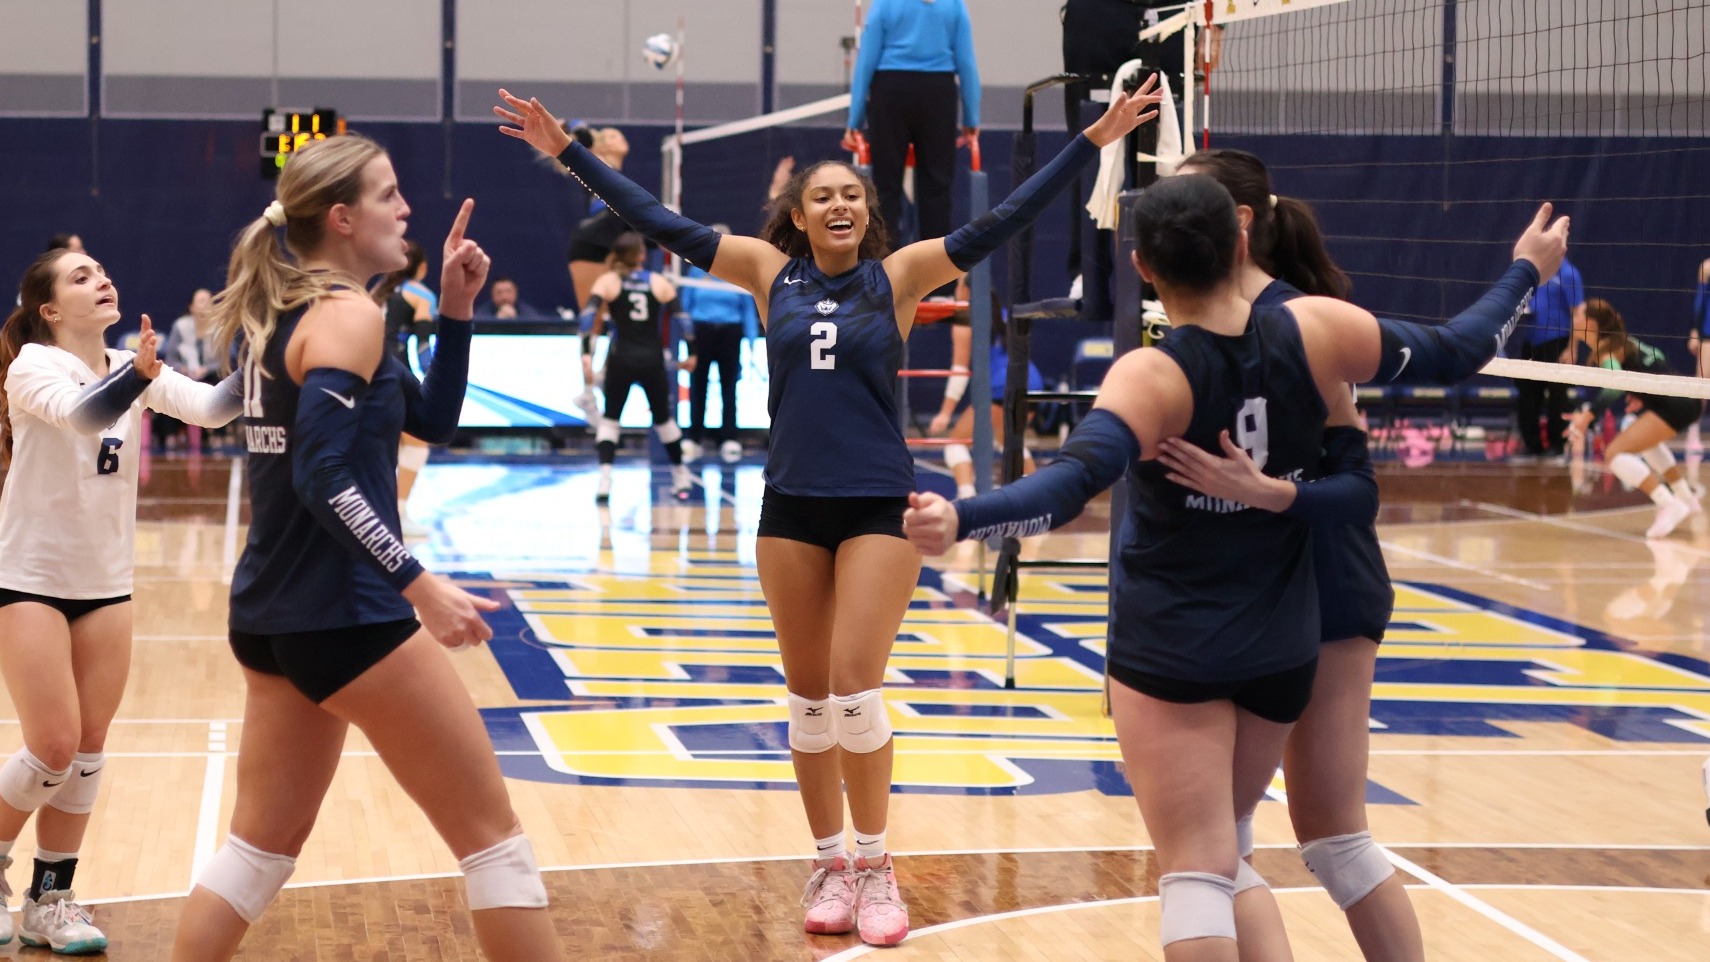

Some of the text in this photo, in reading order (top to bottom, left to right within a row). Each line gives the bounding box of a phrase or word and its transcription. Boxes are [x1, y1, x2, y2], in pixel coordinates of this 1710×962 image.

[628, 291, 650, 321] 3
[810, 321, 838, 370] 2
[97, 437, 124, 475] 6
[1236, 396, 1269, 472] 9
[327, 486, 412, 573] MONARCHS
